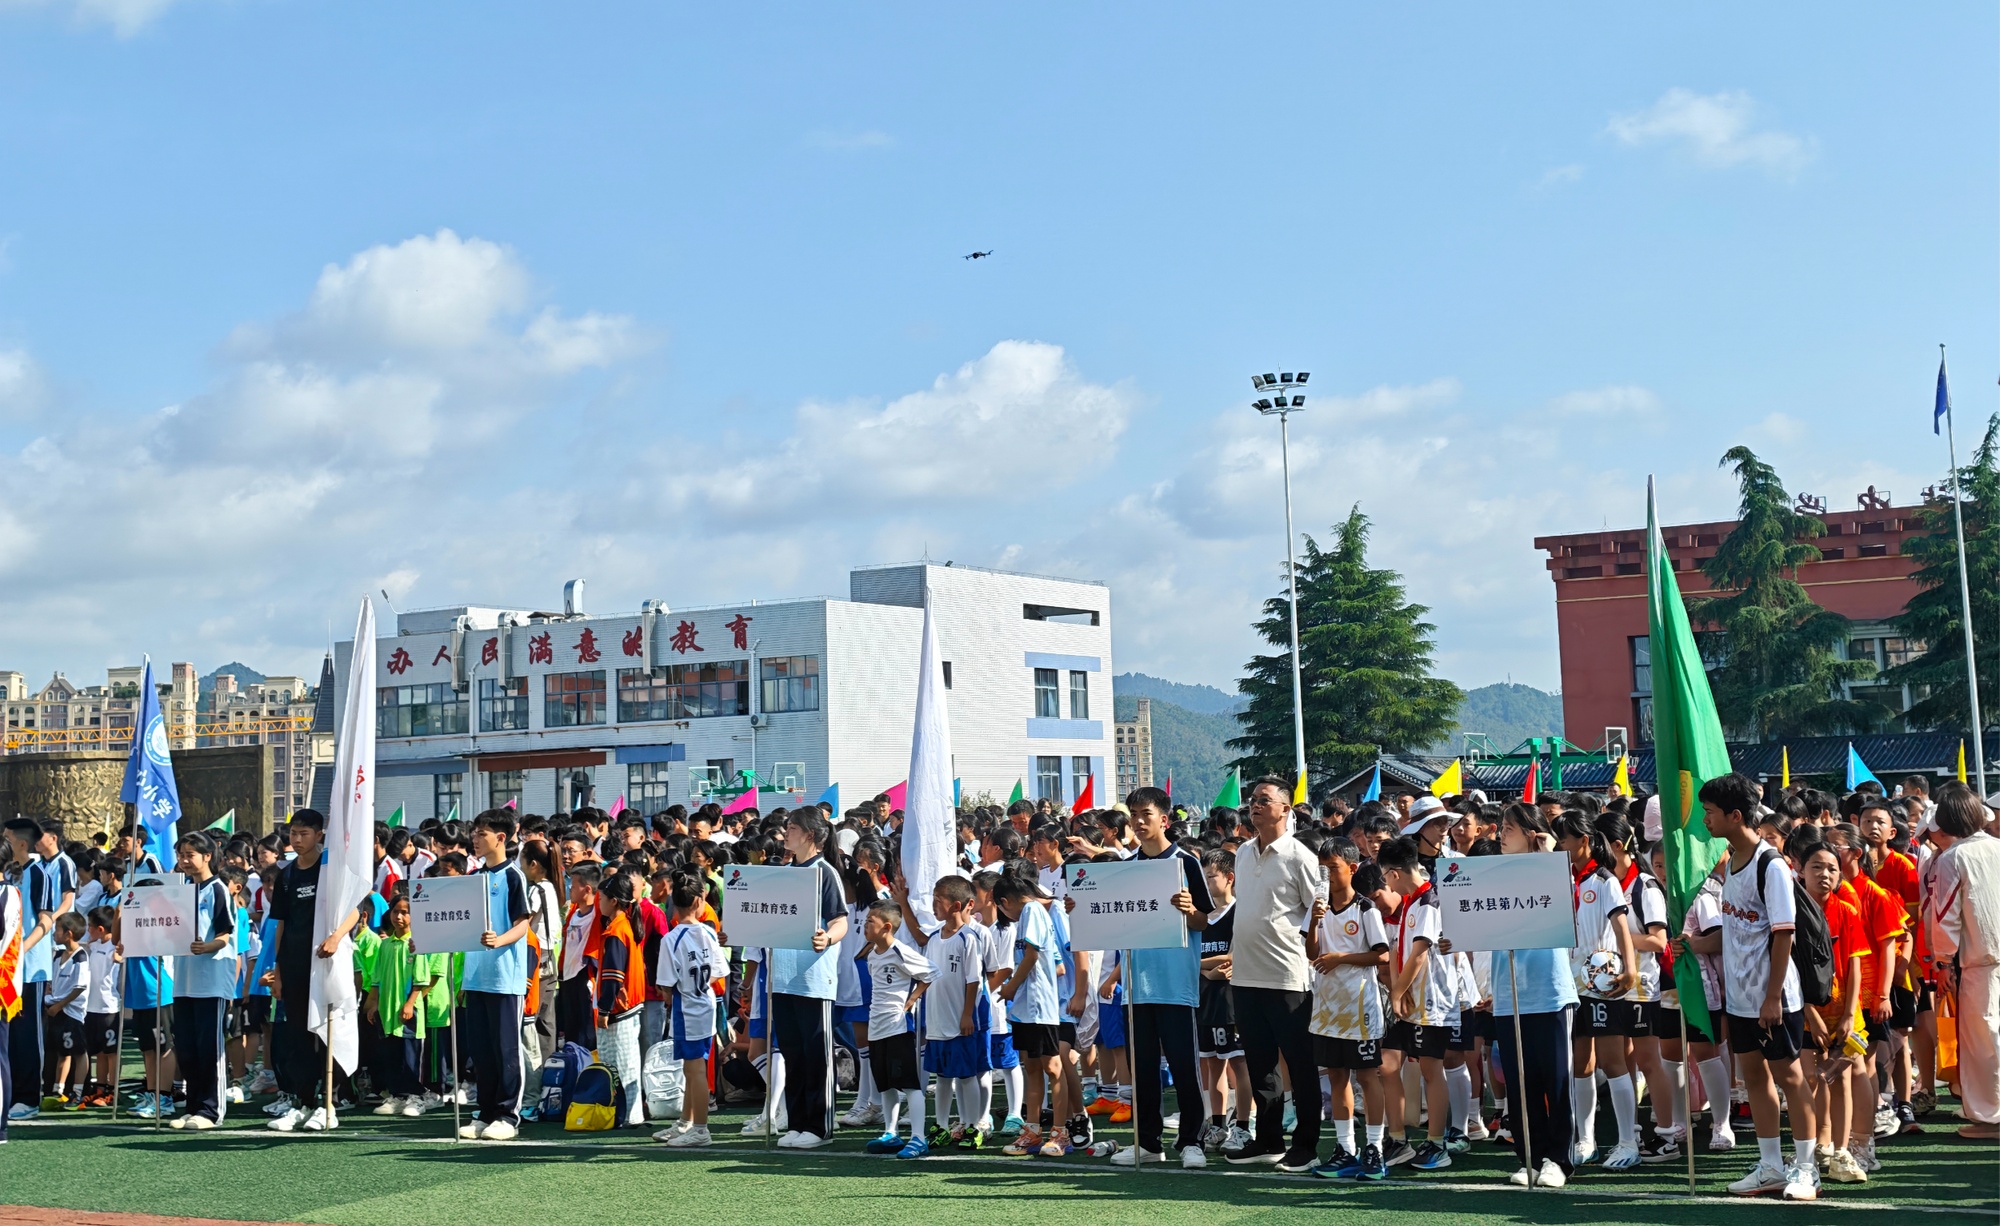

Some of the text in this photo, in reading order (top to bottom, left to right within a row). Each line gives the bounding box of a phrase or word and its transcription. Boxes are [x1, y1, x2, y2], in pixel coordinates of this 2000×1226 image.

[387, 614, 752, 675] 办人民满意的教育
[1090, 899, 1159, 914] 涟江教育党委
[1459, 895, 1552, 912] 惠水县第八小学
[1201, 941, 1228, 953] 江教育党
[951, 962, 957, 973] 11
[689, 963, 711, 997] 10
[887, 974, 892, 984] 6
[243, 1009, 251, 1026] 1
[1590, 1003, 1608, 1021] 16
[1633, 1004, 1642, 1023] 7
[63, 1031, 73, 1049] 3
[105, 1029, 116, 1046] 2
[1212, 1027, 1228, 1046] 18
[1414, 1025, 1423, 1043] 2
[1358, 1039, 1376, 1055] 23
